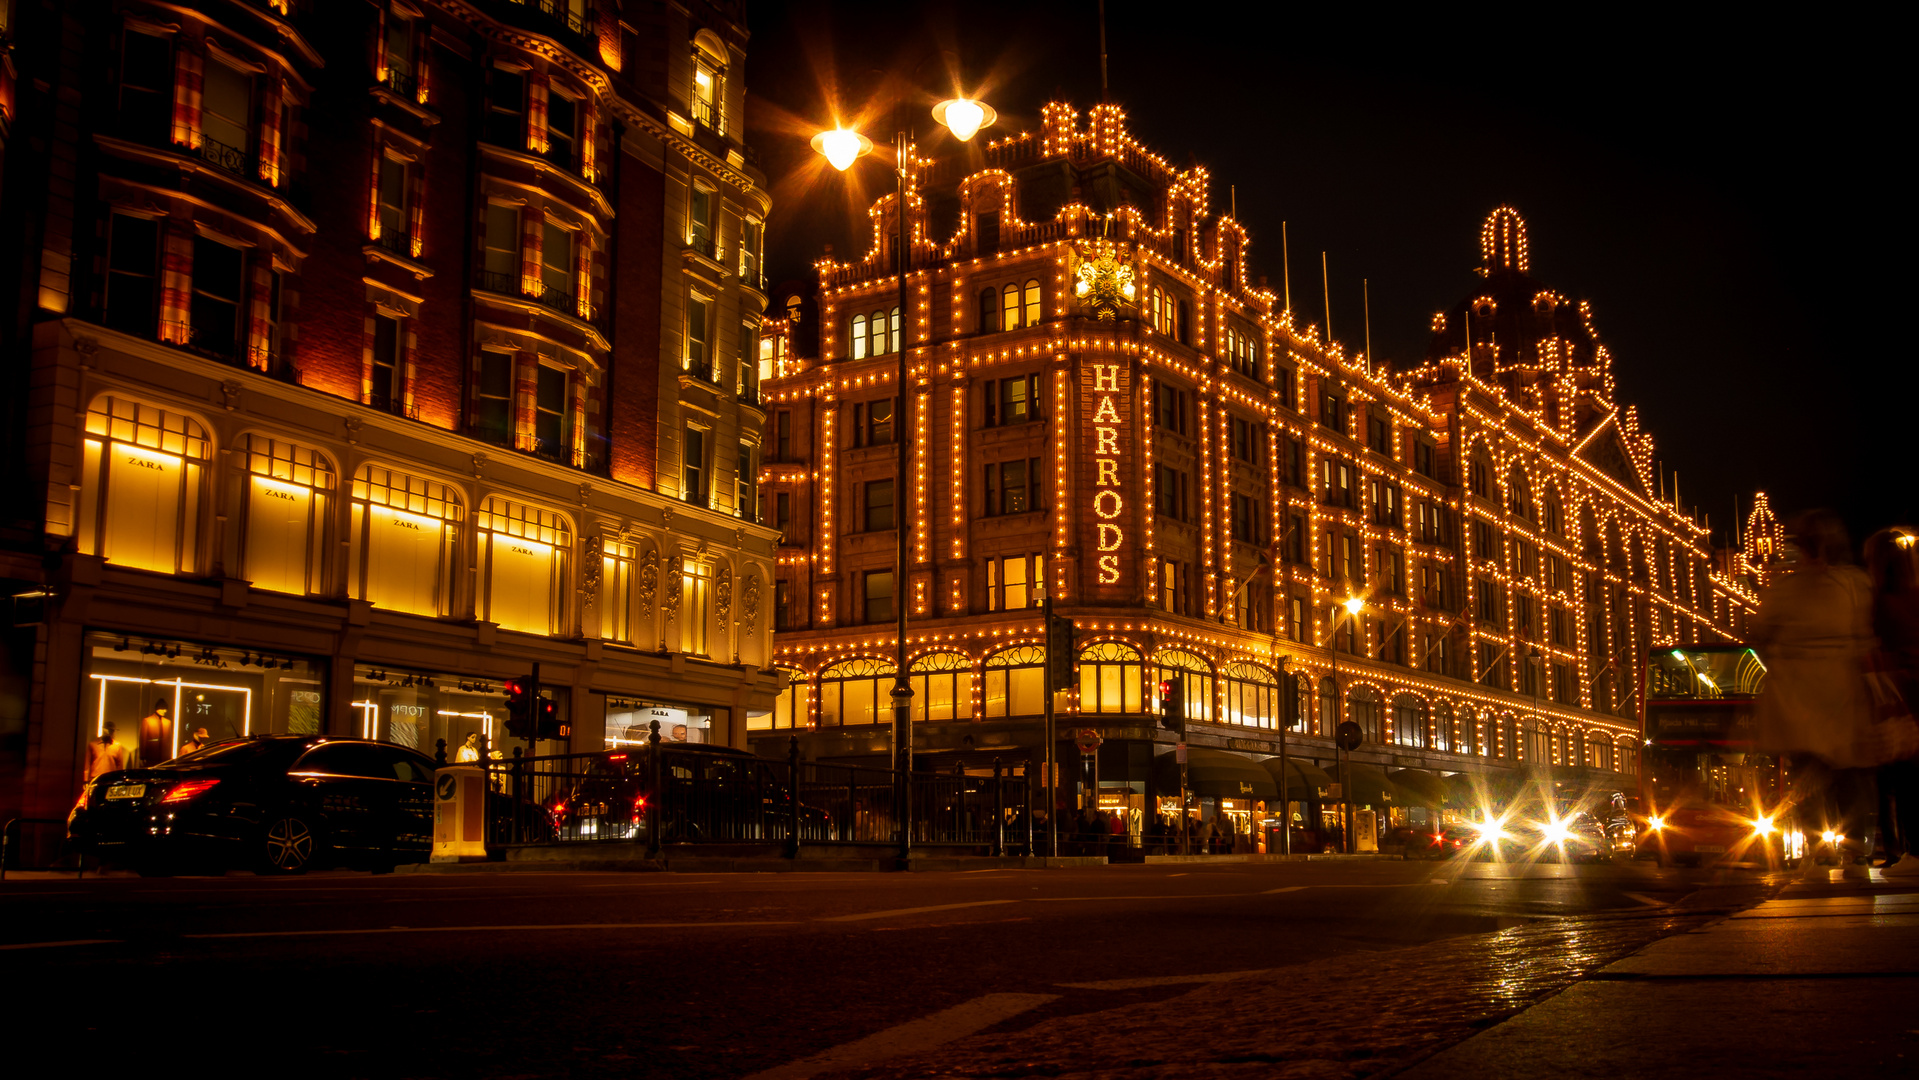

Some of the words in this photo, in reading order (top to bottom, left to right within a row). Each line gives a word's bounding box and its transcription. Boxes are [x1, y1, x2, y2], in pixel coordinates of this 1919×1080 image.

[128, 457, 164, 471] ZARA
[1093, 364, 1123, 584] HARRODS
[265, 489, 295, 501] ZARA
[393, 519, 419, 530] ZARA
[511, 546, 534, 556] ZARA
[195, 658, 228, 668] ZARA
[651, 709, 669, 717] ZARA
